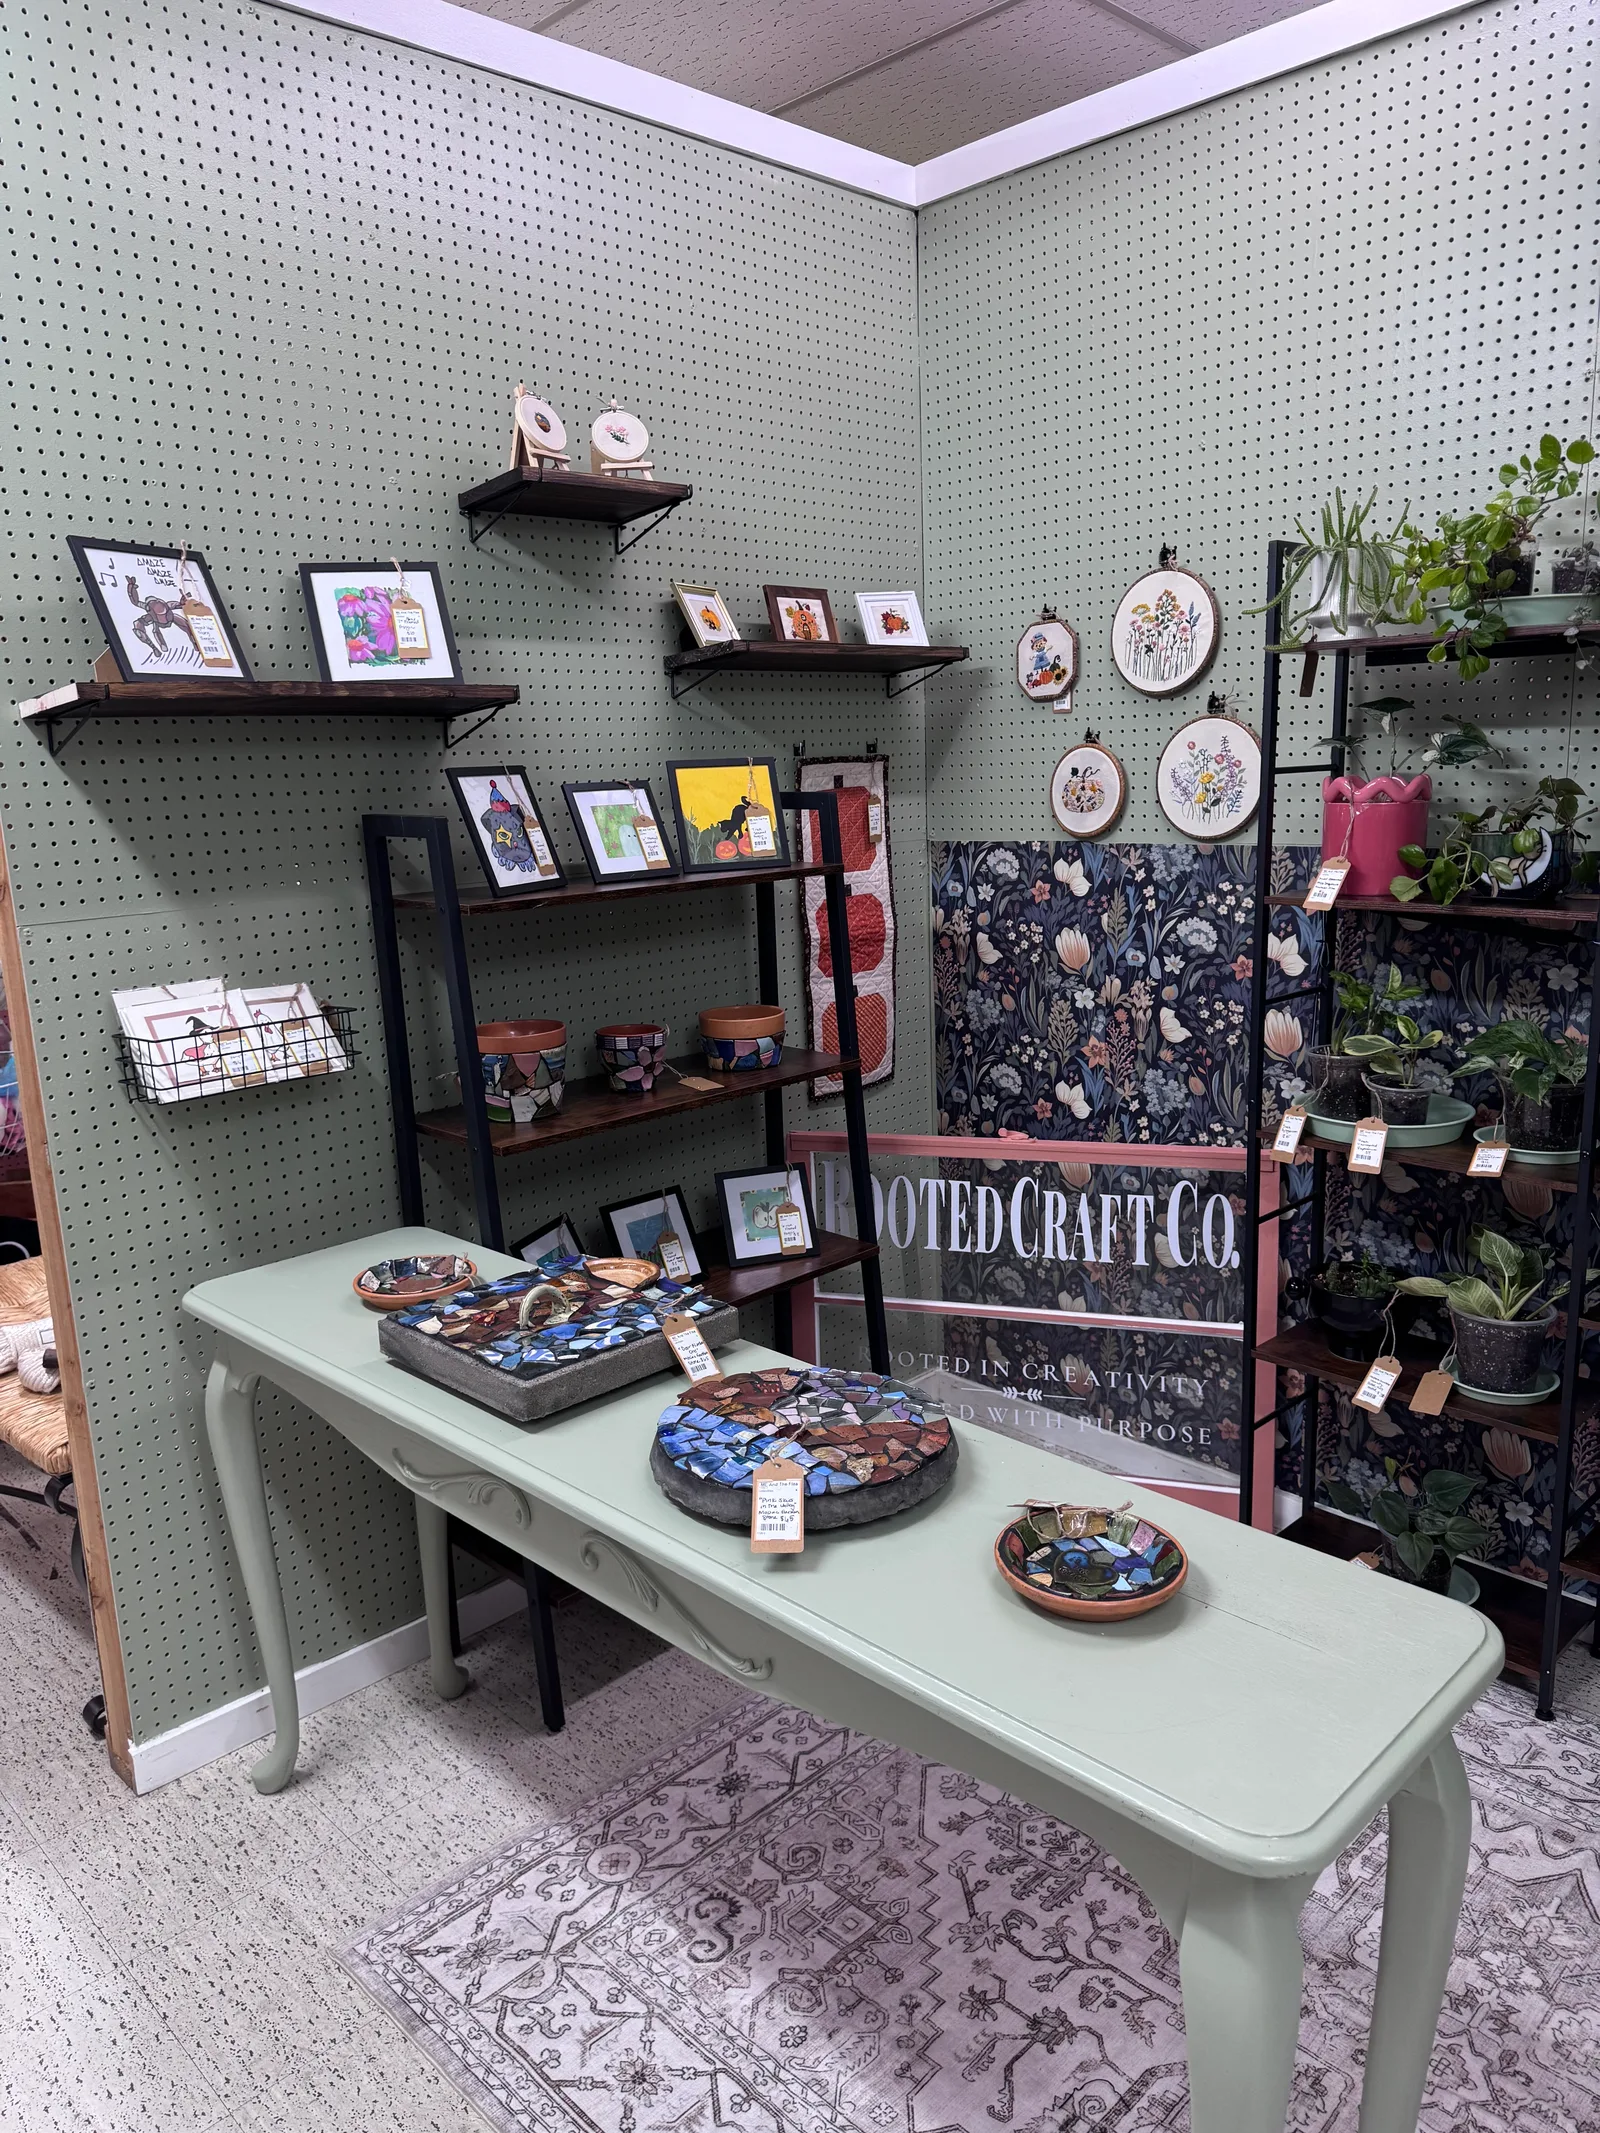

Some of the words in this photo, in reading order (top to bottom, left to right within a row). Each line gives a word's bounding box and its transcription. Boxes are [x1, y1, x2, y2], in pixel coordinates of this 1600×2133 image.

[137, 558, 166, 568] AMAZE
[146, 567, 174, 579] AMAZE
[981, 1359, 1011, 1378] IN
[1022, 1362, 1209, 1396] CREATIVITY
[987, 1406, 1064, 1430] WITH
[1077, 1415, 1212, 1446] PURPOSE
